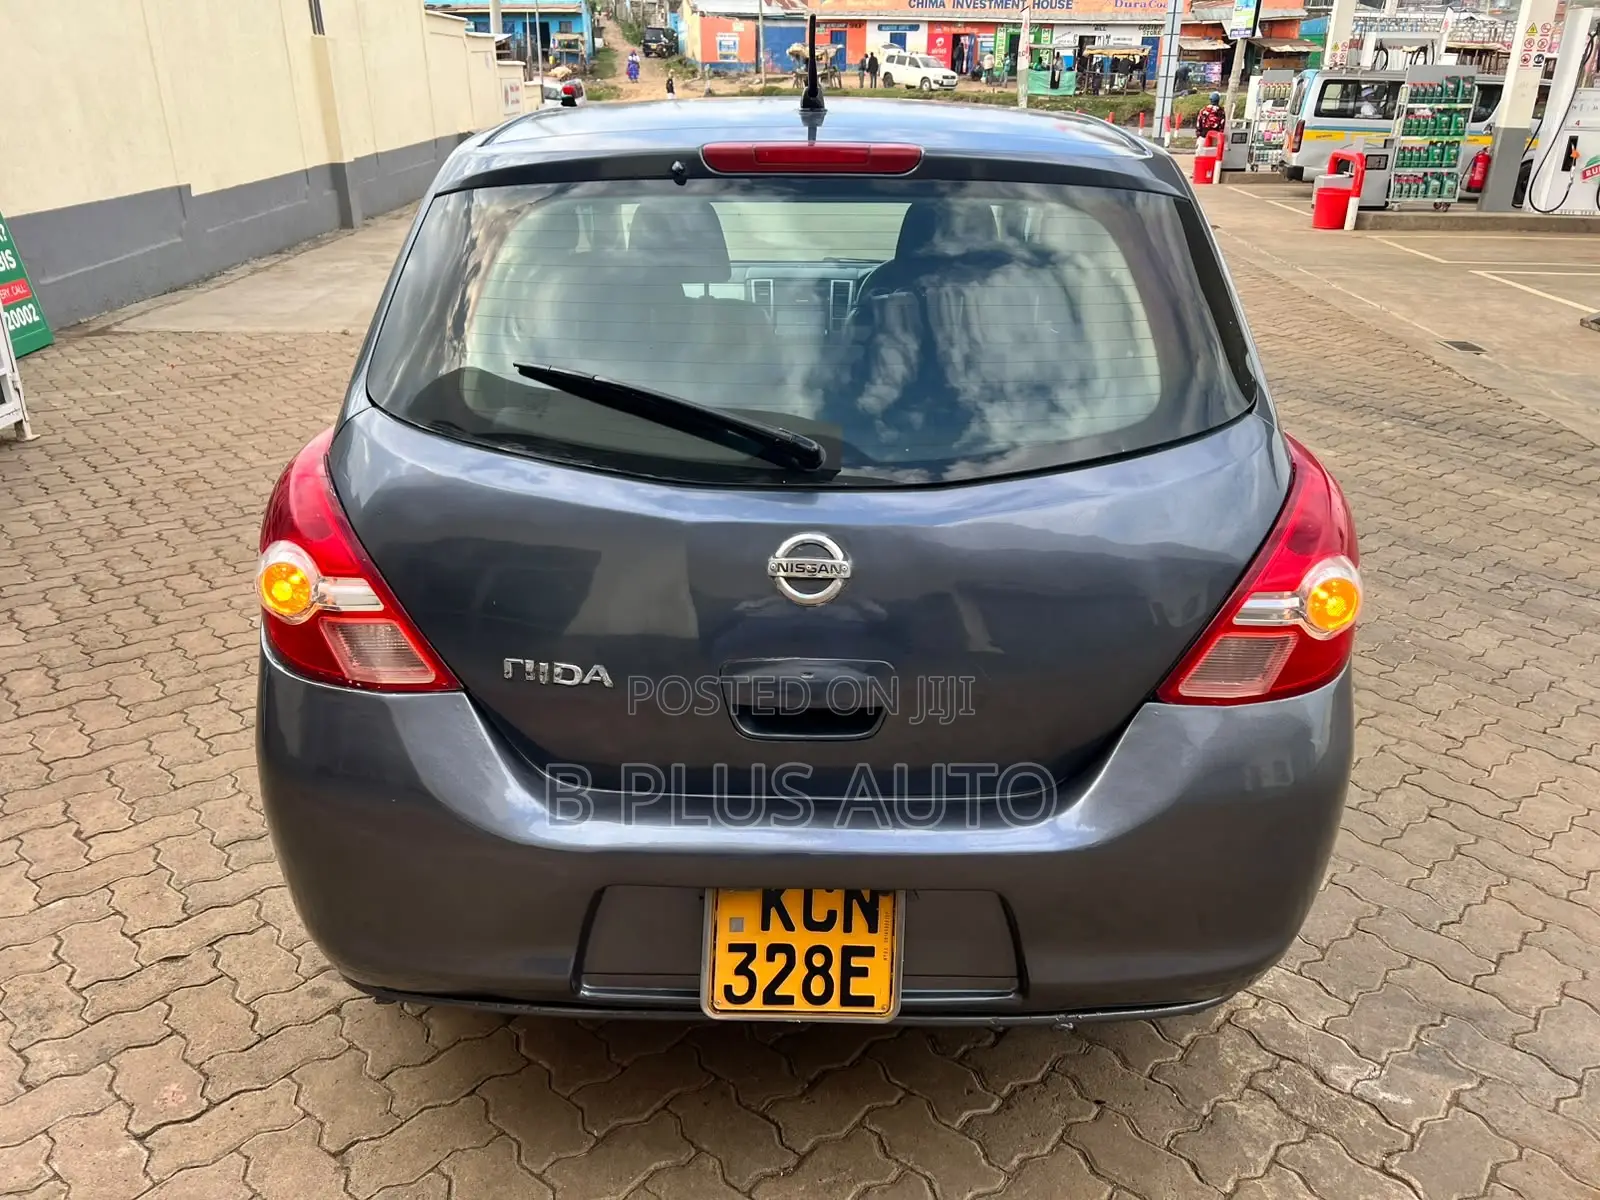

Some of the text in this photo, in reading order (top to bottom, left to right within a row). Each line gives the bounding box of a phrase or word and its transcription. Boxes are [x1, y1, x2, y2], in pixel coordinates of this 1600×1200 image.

[908, 0, 1073, 9] CHIMA INVESTMENT HOUSE
[1585, 166, 1600, 176] RU
[777, 562, 841, 575] NISSAN
[761, 888, 880, 934] KCN
[723, 943, 876, 1007] 328E
